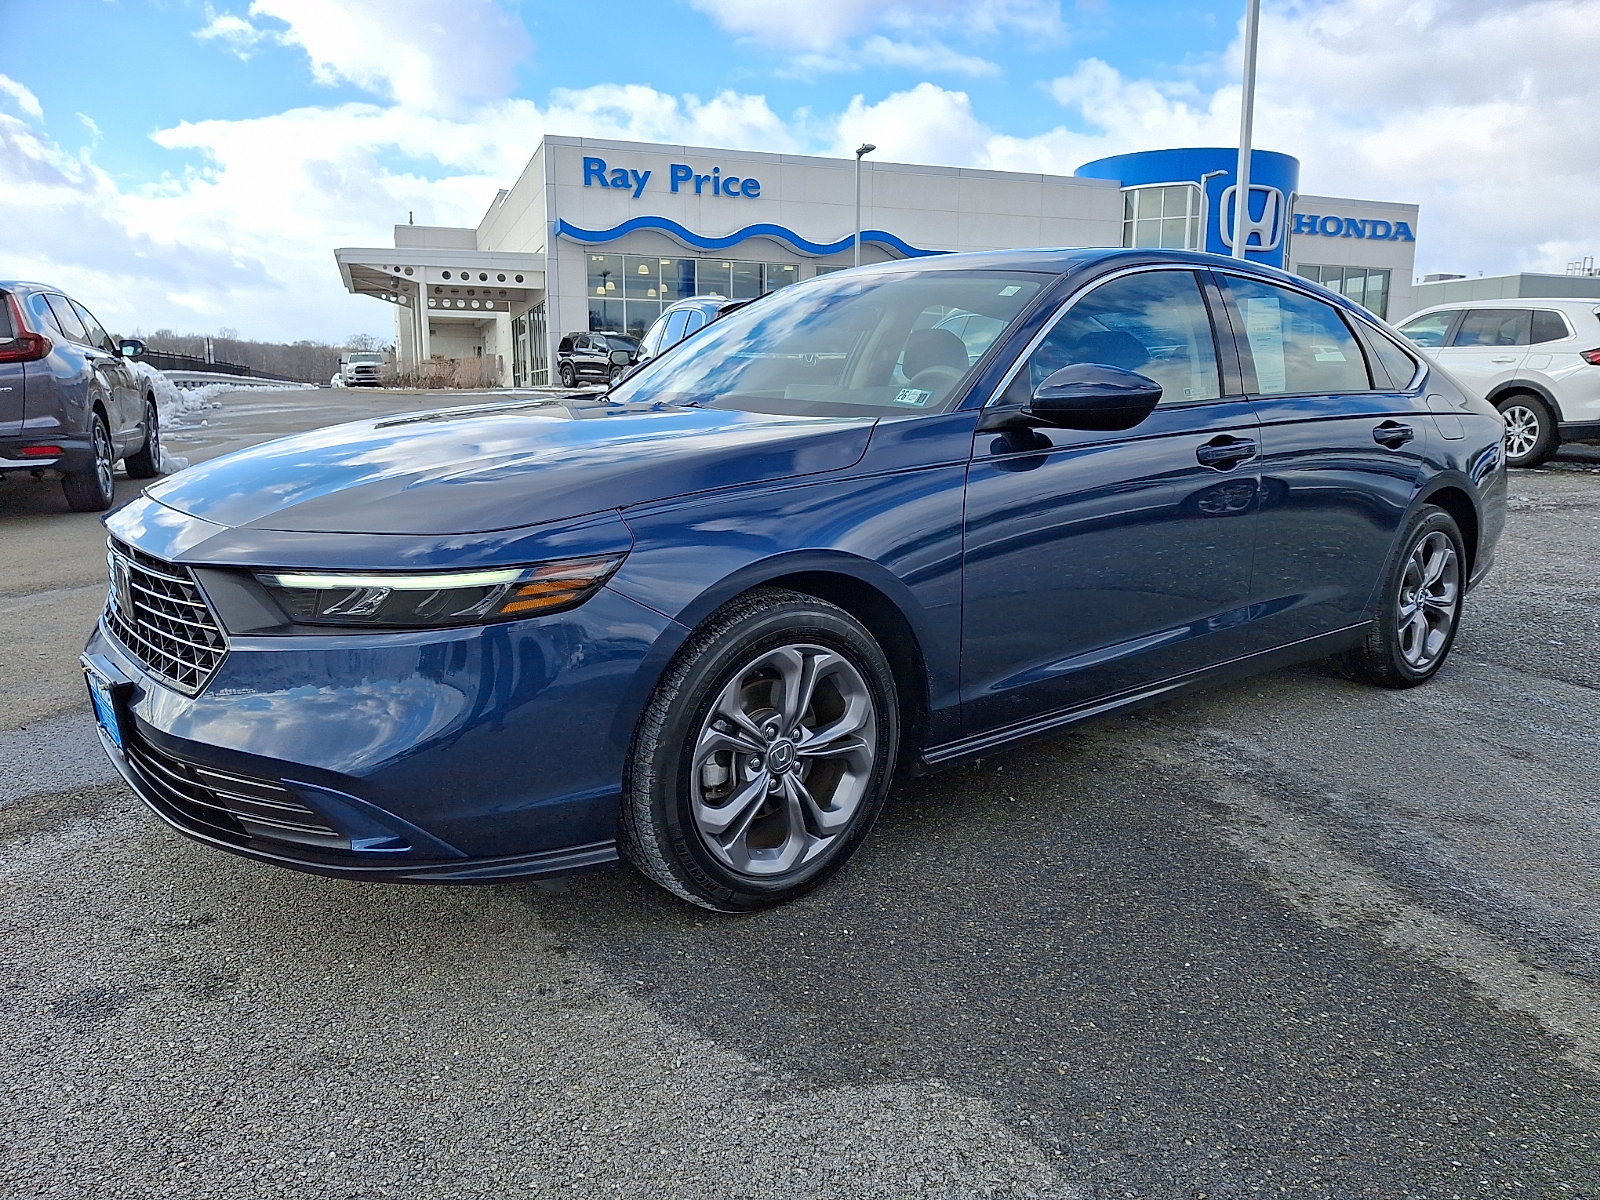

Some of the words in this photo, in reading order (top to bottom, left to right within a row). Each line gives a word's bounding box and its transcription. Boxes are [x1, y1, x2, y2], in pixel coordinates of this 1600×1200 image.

[583, 156, 652, 199] Ray
[670, 163, 761, 198] Price
[1293, 213, 1415, 241] HONDA
